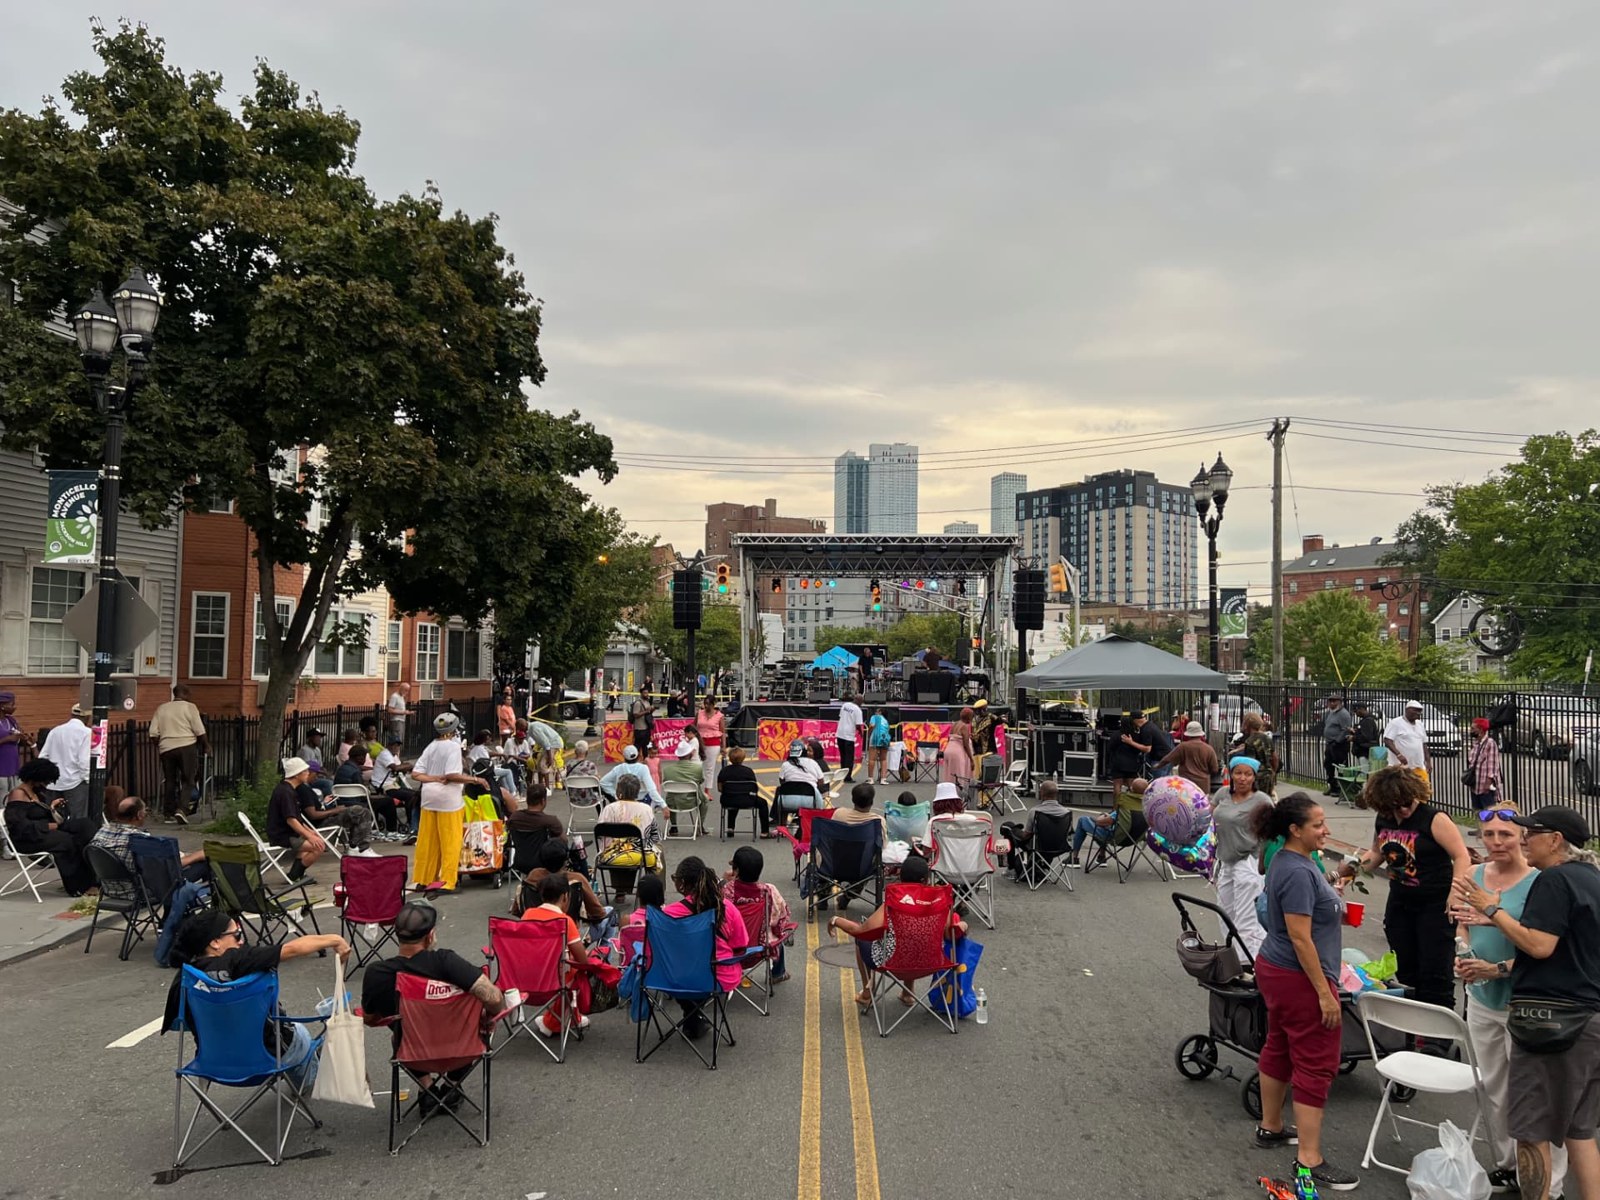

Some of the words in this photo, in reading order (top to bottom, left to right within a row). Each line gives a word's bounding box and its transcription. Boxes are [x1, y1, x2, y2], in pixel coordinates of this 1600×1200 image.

[52, 484, 97, 518] MONTICELLO
[60, 492, 85, 518] AVENUE
[653, 727, 685, 739] montice
[658, 737, 674, 750] ART
